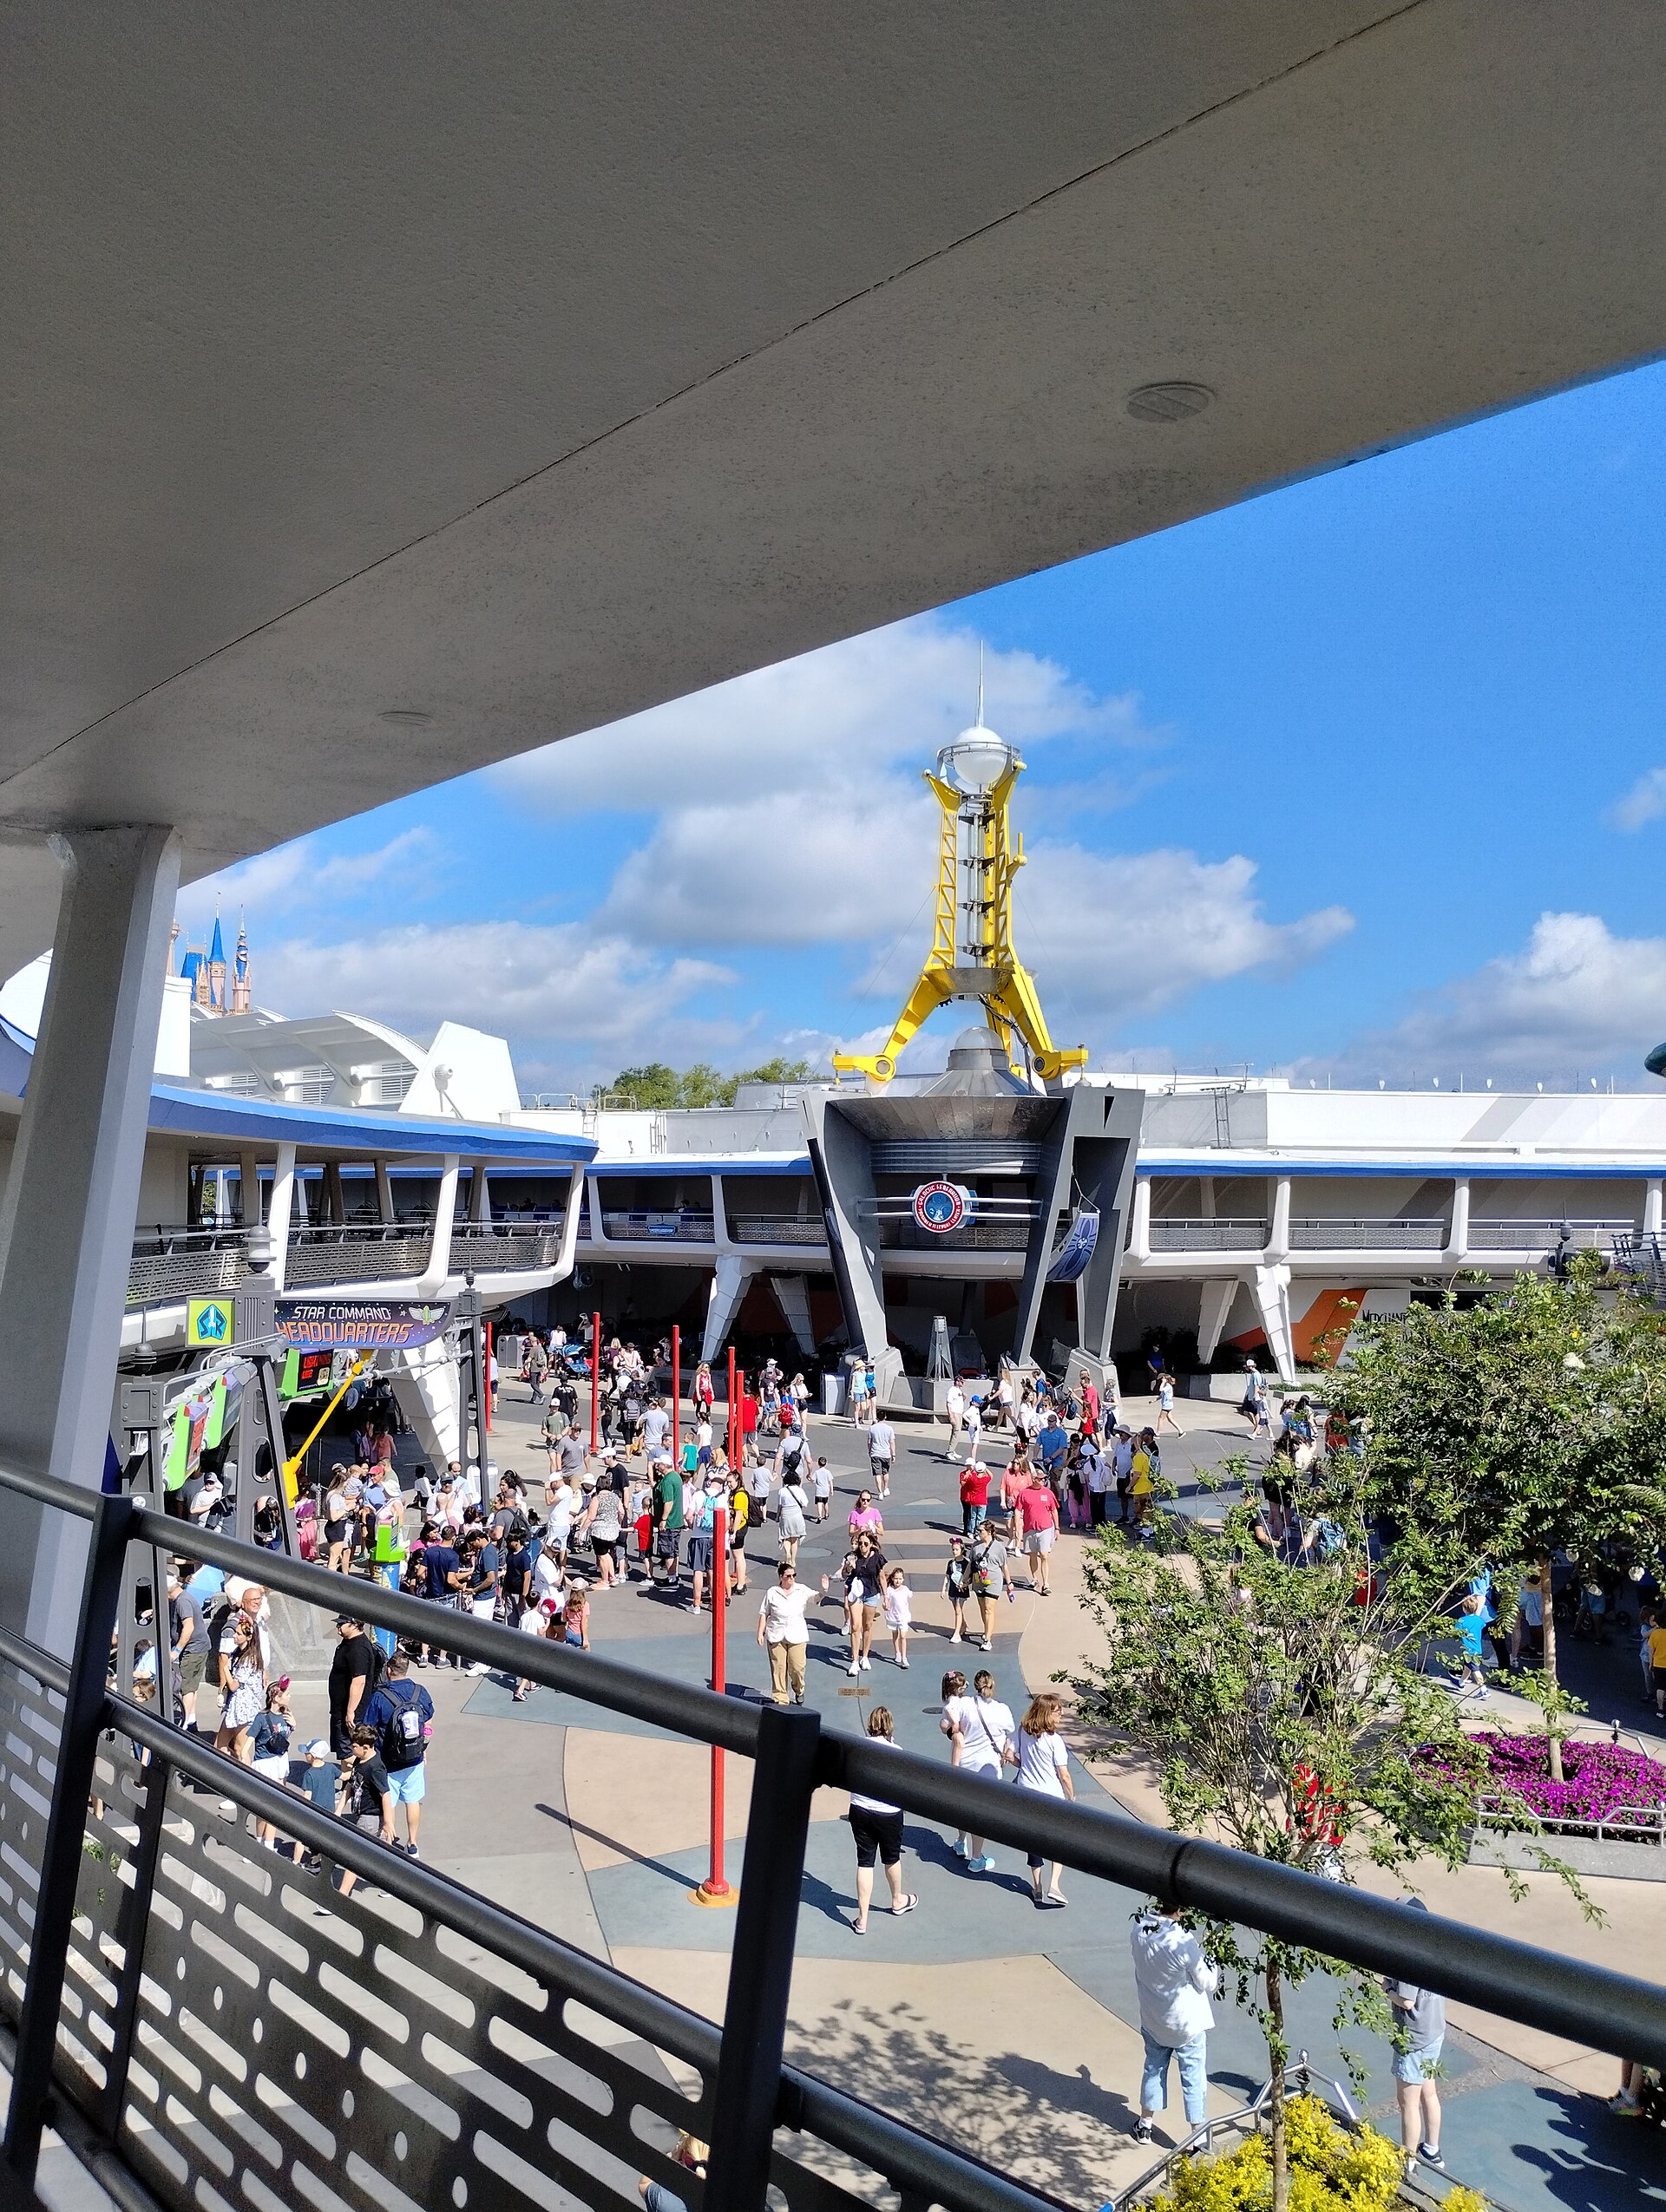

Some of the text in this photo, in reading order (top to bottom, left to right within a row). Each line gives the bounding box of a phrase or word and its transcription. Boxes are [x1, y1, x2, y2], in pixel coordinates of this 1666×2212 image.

[292, 1306, 391, 1320] STAR COMMAND
[275, 1321, 414, 1344] HEADQUARTERS
